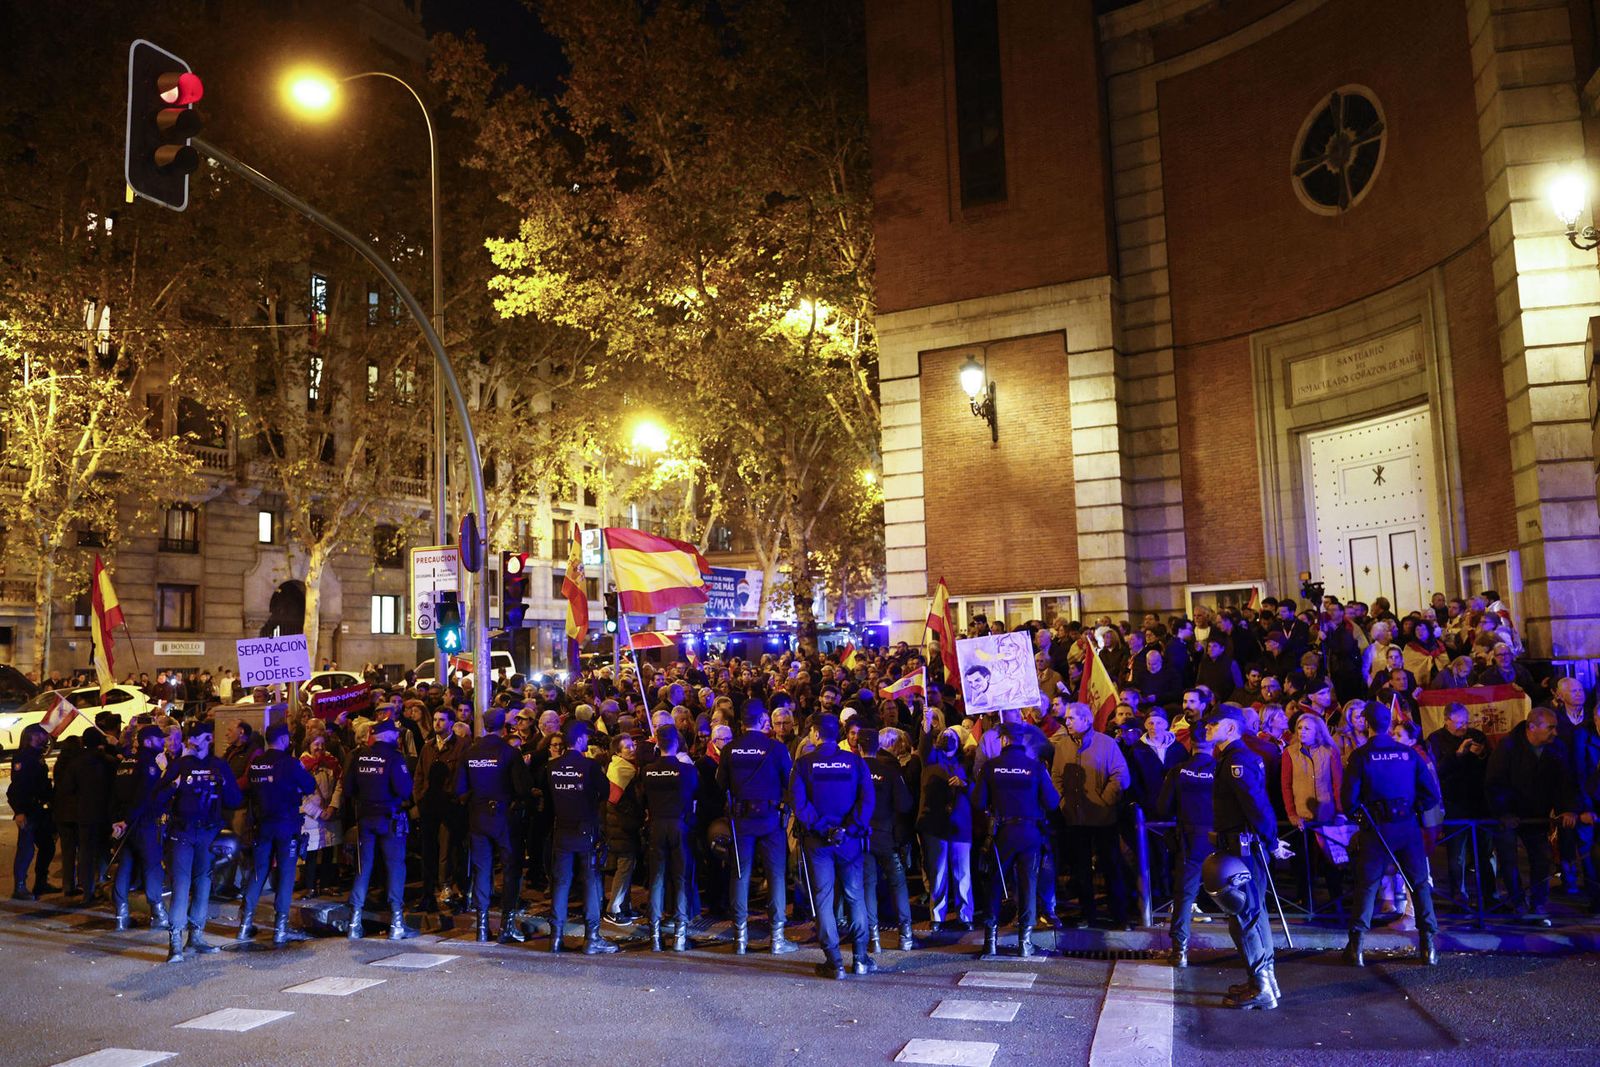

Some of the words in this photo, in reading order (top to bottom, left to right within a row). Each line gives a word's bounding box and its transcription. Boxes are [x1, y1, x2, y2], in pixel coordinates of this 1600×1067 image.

[1336, 345, 1385, 367] SANTUARIO
[1388, 361, 1398, 370] DE
[263, 656, 280, 667] DE
[246, 666, 305, 682] PODERES
[1371, 752, 1401, 760] U.I.P.
[994, 767, 1027, 775] POLICIA
[1179, 768, 1214, 779] POLICIA
